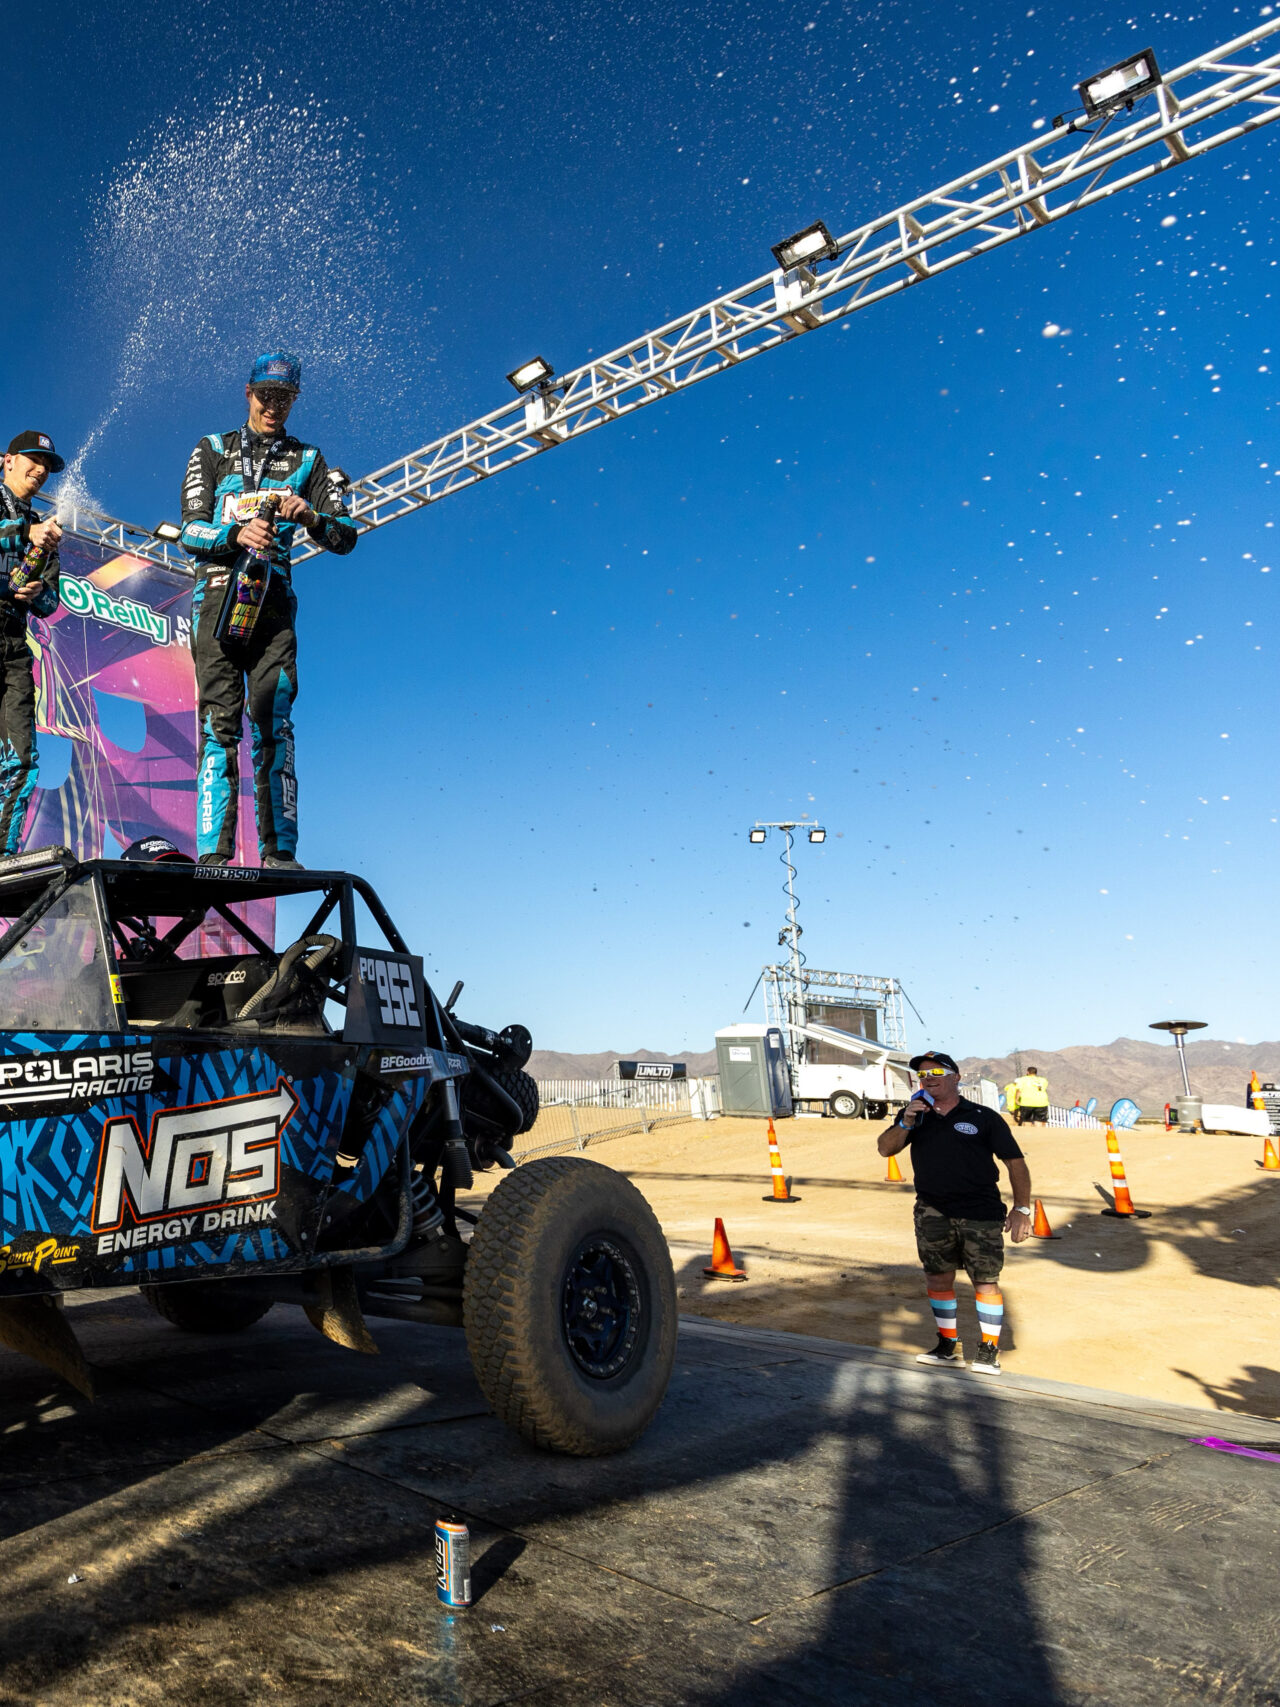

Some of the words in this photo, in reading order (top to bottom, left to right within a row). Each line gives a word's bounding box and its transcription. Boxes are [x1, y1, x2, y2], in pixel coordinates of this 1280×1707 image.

[59, 576, 166, 640] O'Reilly
[202, 756, 215, 835] POLARIS
[193, 866, 260, 882] ANDERSON
[207, 969, 247, 986] sparco
[374, 959, 422, 1027] 952
[70, 1074, 155, 1099] RACING
[637, 1064, 672, 1078] UNLTD
[97, 1085, 296, 1226] NOS
[96, 1215, 199, 1256] ENERGY
[202, 1200, 278, 1233] DRINK
